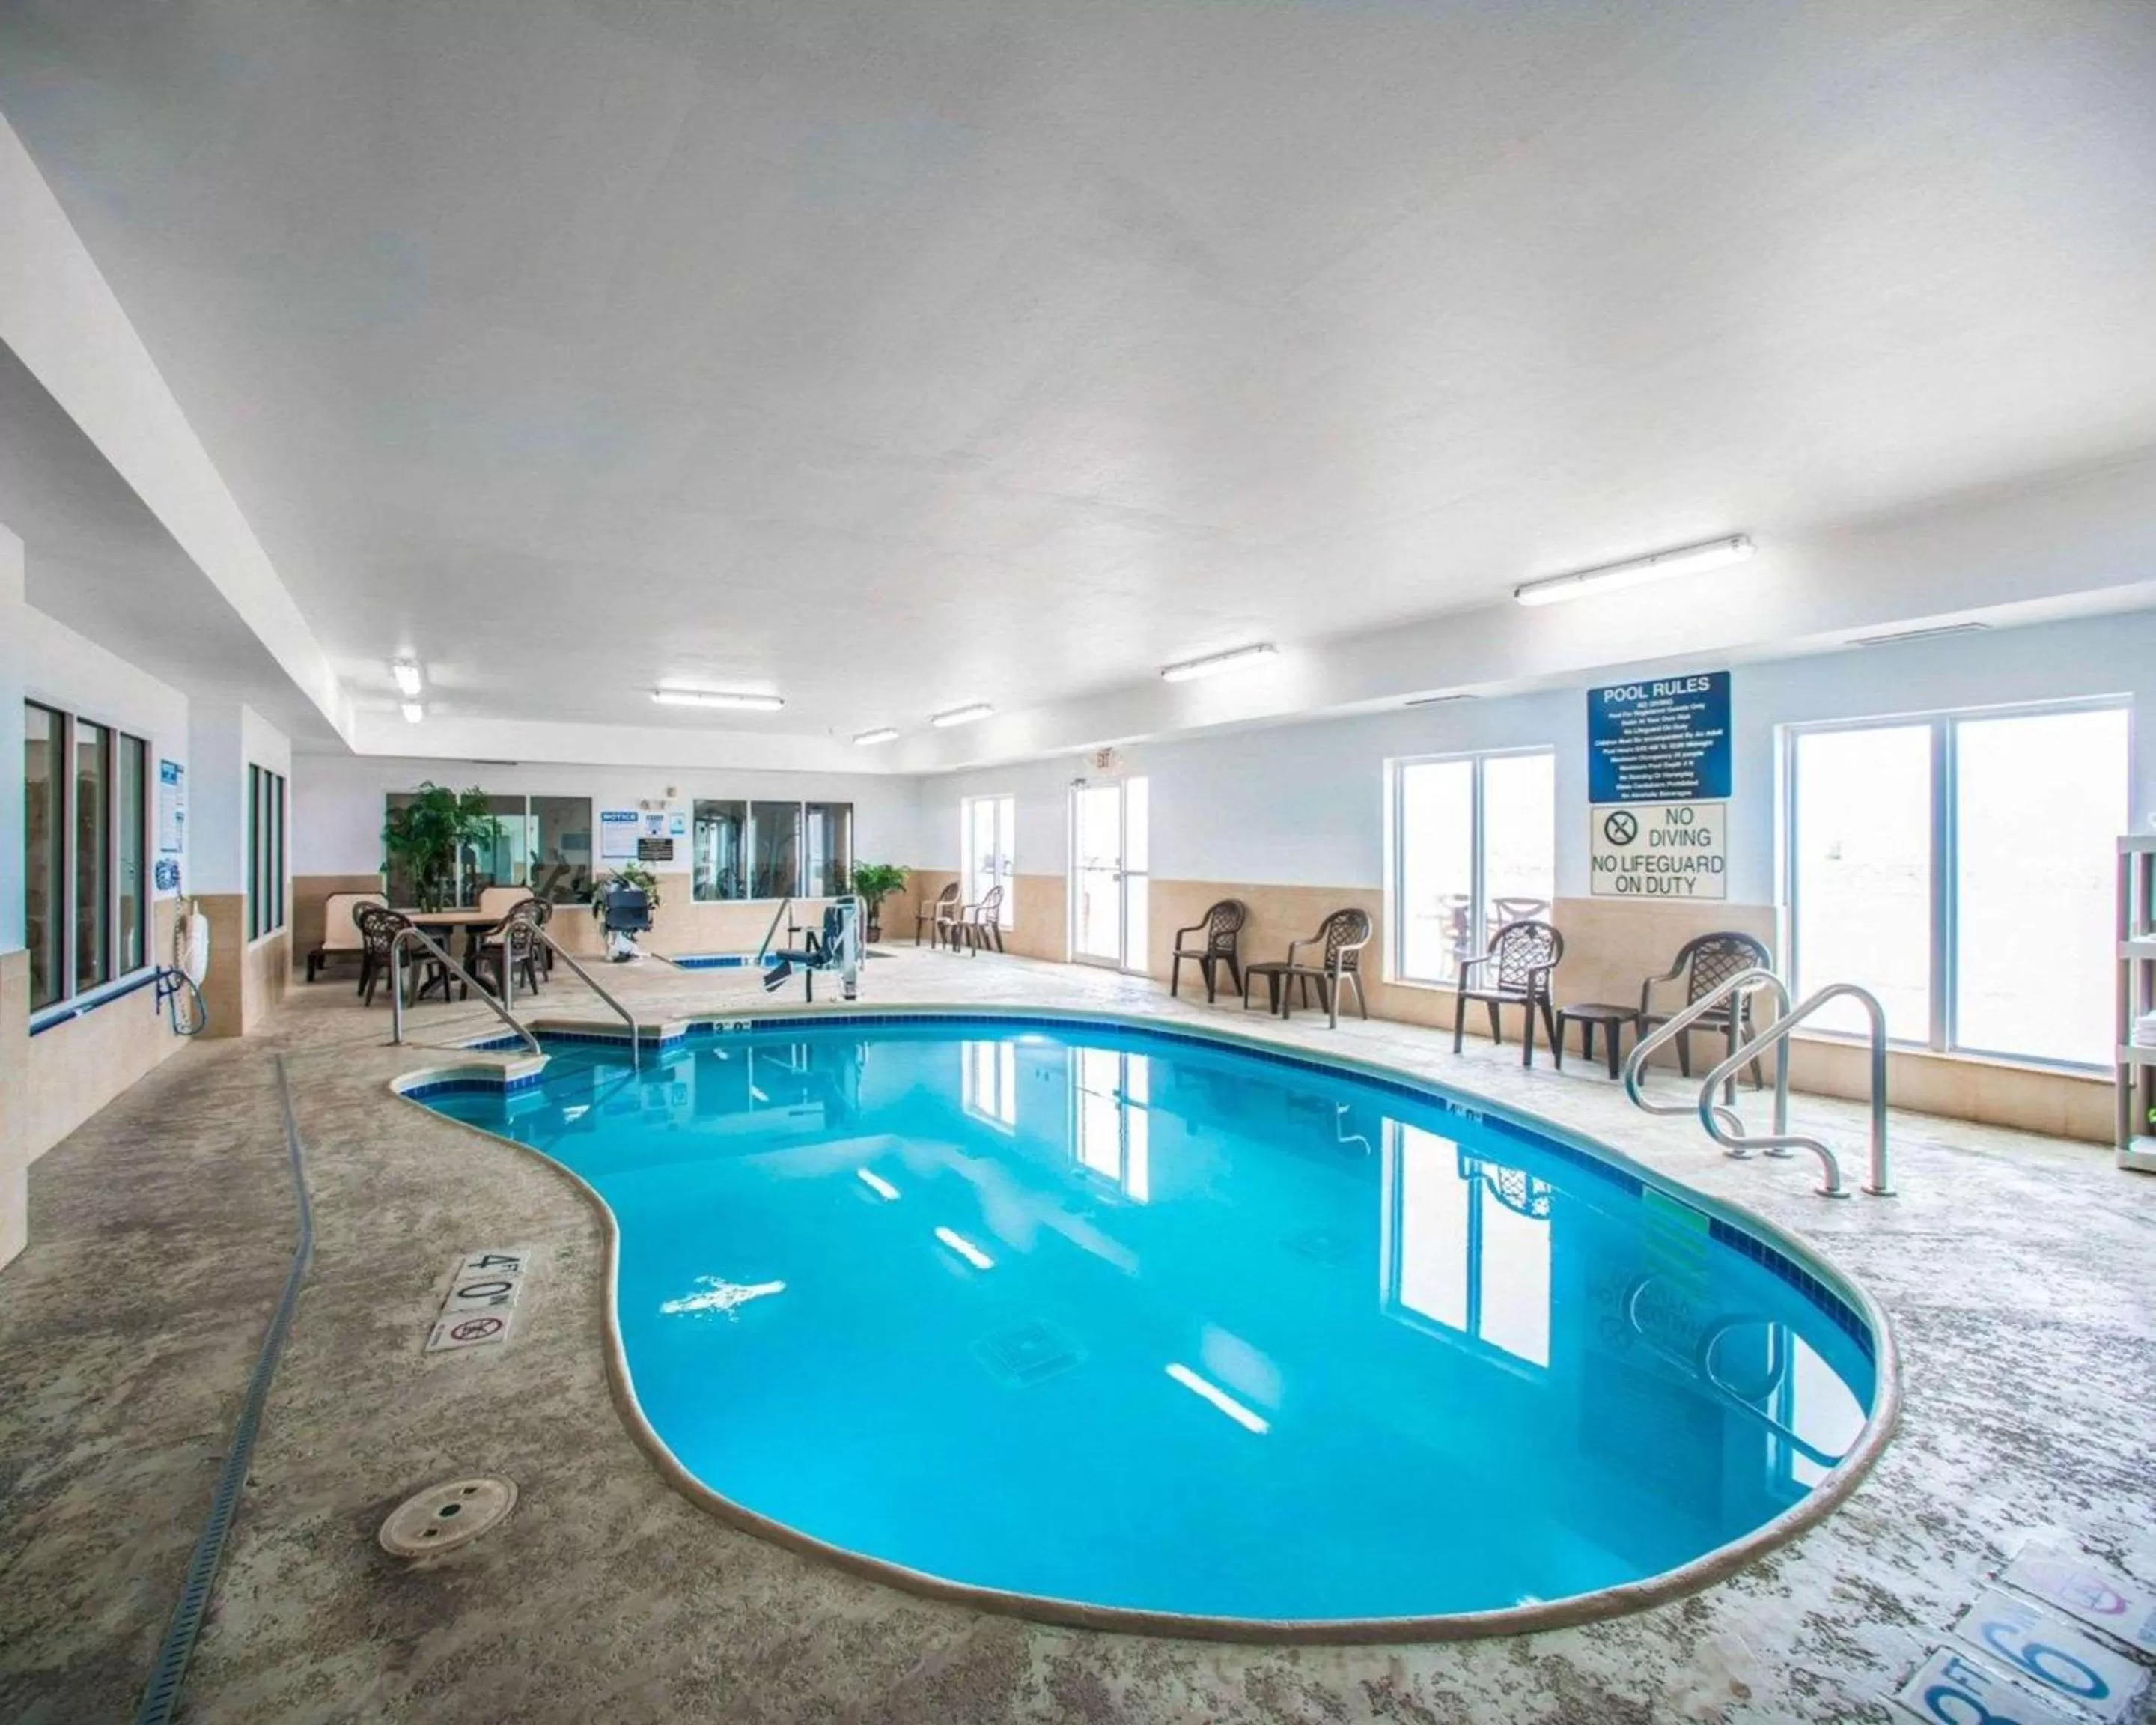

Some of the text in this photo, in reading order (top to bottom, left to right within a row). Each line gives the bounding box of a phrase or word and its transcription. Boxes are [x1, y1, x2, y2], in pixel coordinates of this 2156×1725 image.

[1604, 676, 1711, 703] POOL RULES
[1666, 806, 1694, 826] NO
[1649, 827, 1711, 847] DIVING
[1592, 855, 1724, 874] NO LIFEGUARD
[1615, 875, 1697, 895] ON DUTY
